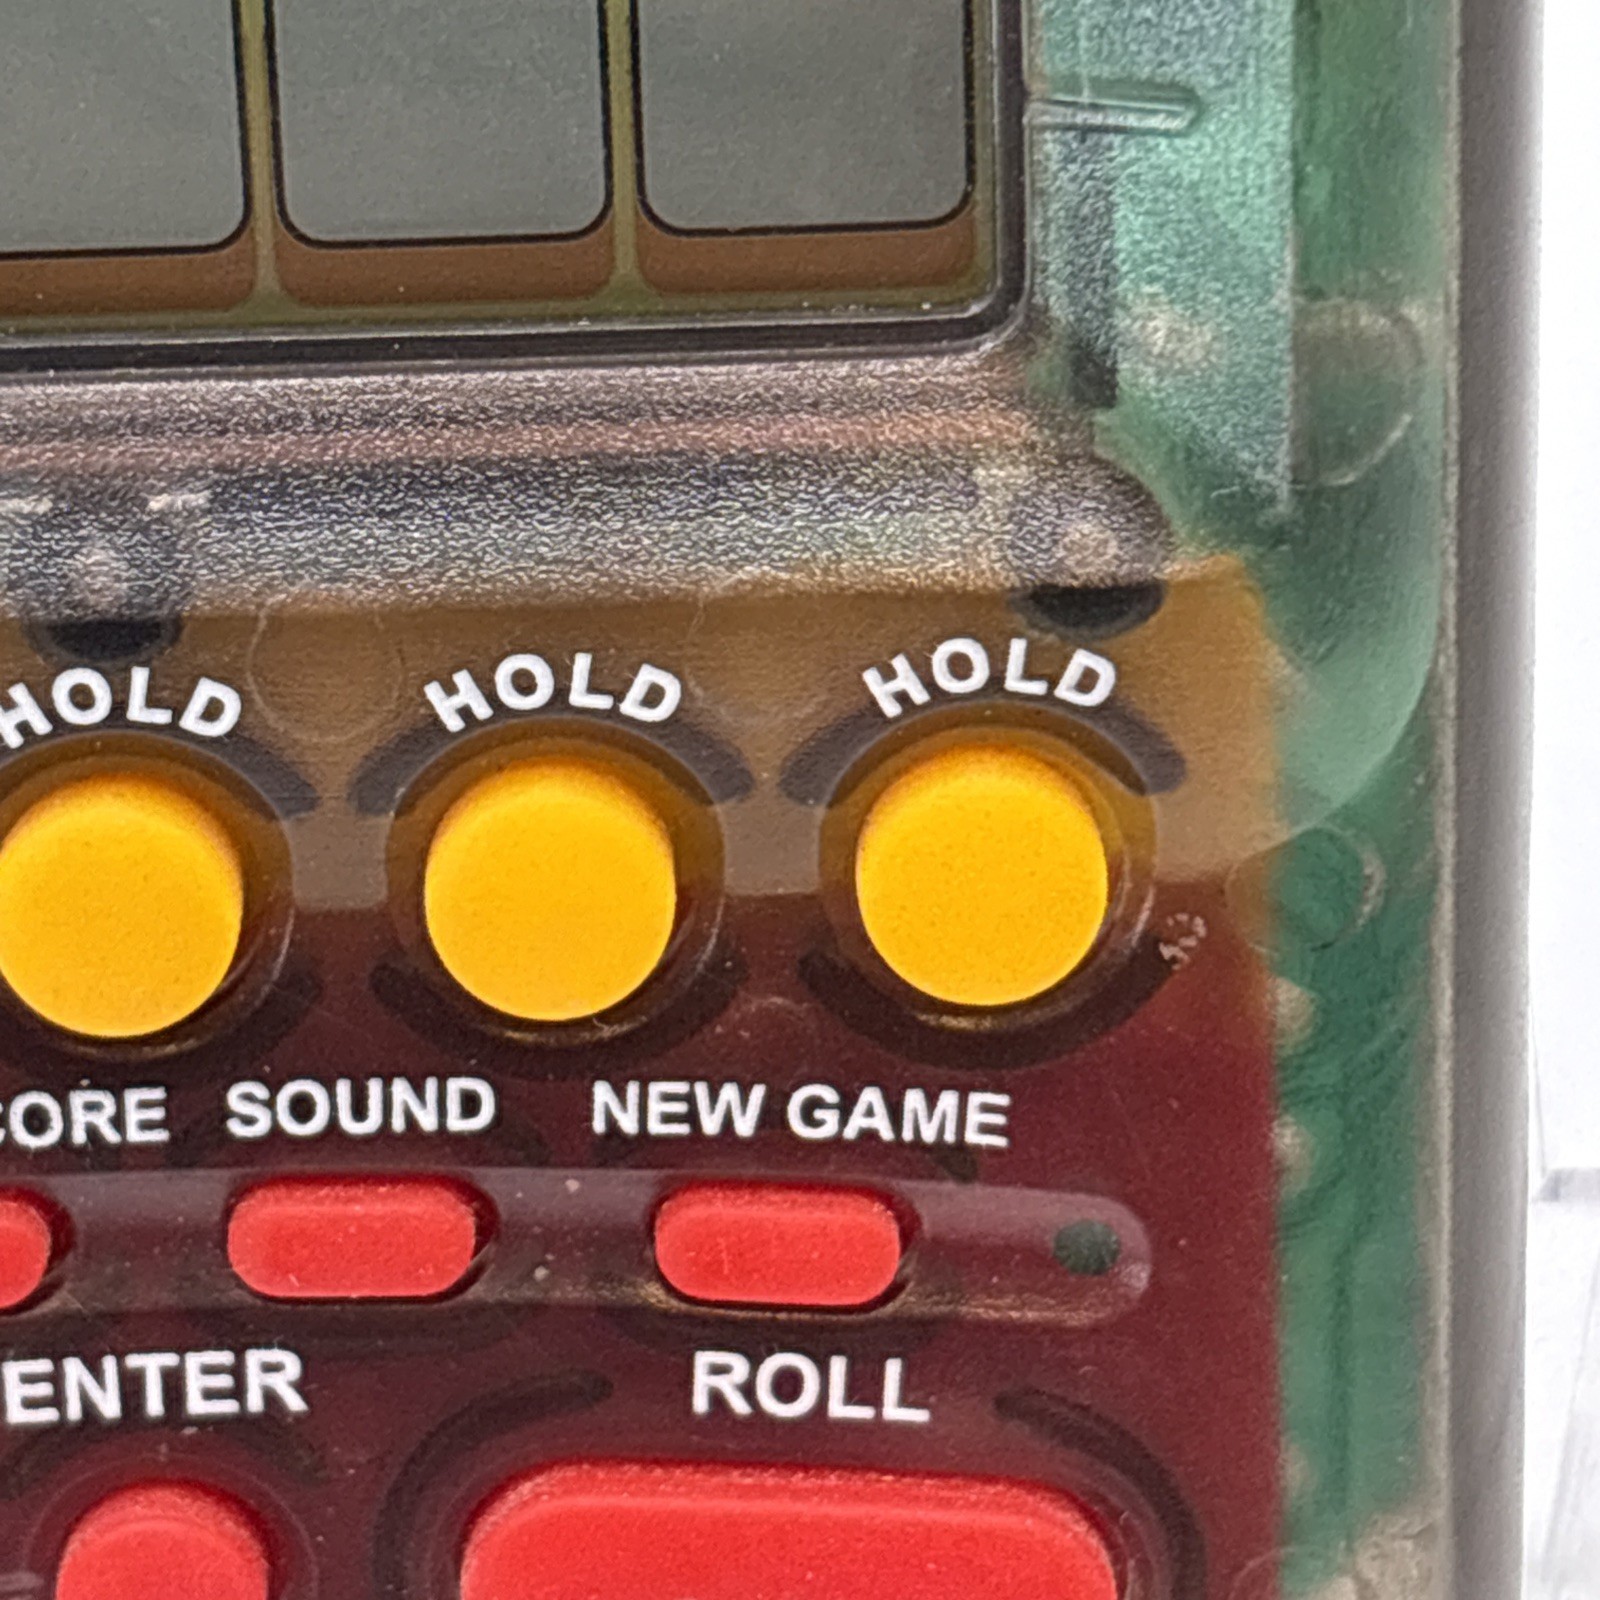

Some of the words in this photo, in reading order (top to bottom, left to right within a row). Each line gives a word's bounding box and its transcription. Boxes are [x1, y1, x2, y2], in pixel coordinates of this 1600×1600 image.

[0, 664, 243, 750] HOLD
[422, 651, 683, 734] HOLD
[861, 636, 1117, 720] HOLD
[0, 1085, 171, 1150] ORE
[225, 1076, 496, 1139] SOUND
[590, 1079, 767, 1139] NEW
[785, 1082, 1012, 1149] GAME
[0, 1346, 309, 1427] ENTER
[691, 1349, 932, 1426] ROLL
